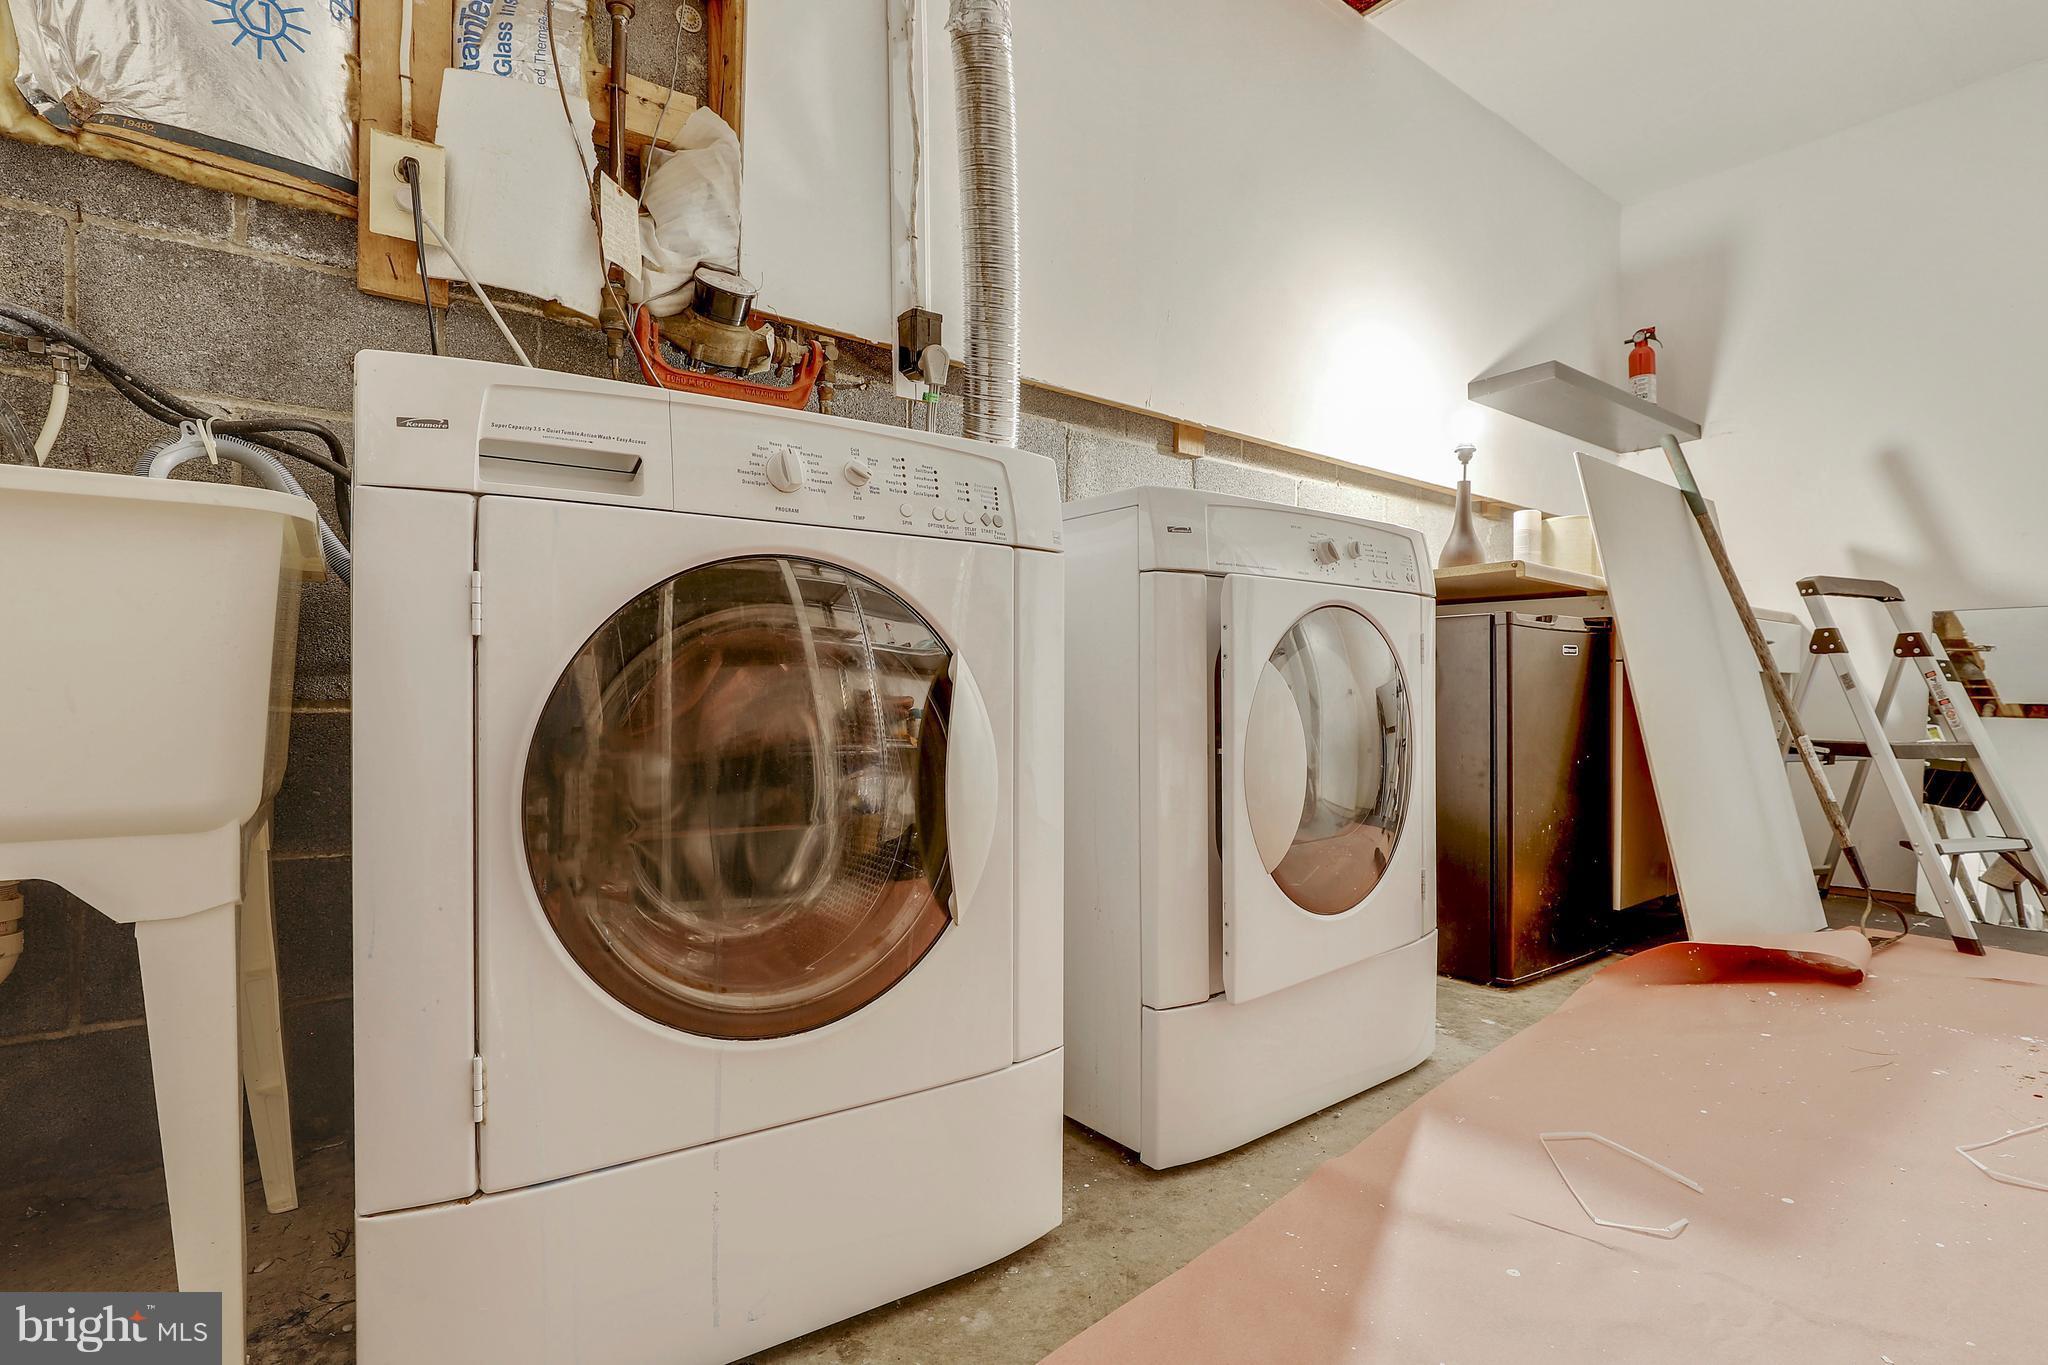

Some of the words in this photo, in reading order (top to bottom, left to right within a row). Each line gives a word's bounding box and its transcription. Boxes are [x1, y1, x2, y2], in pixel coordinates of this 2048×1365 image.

[493, 21, 514, 77] Glass
[405, 420, 449, 429] Kenmore
[508, 423, 533, 432] Capacity
